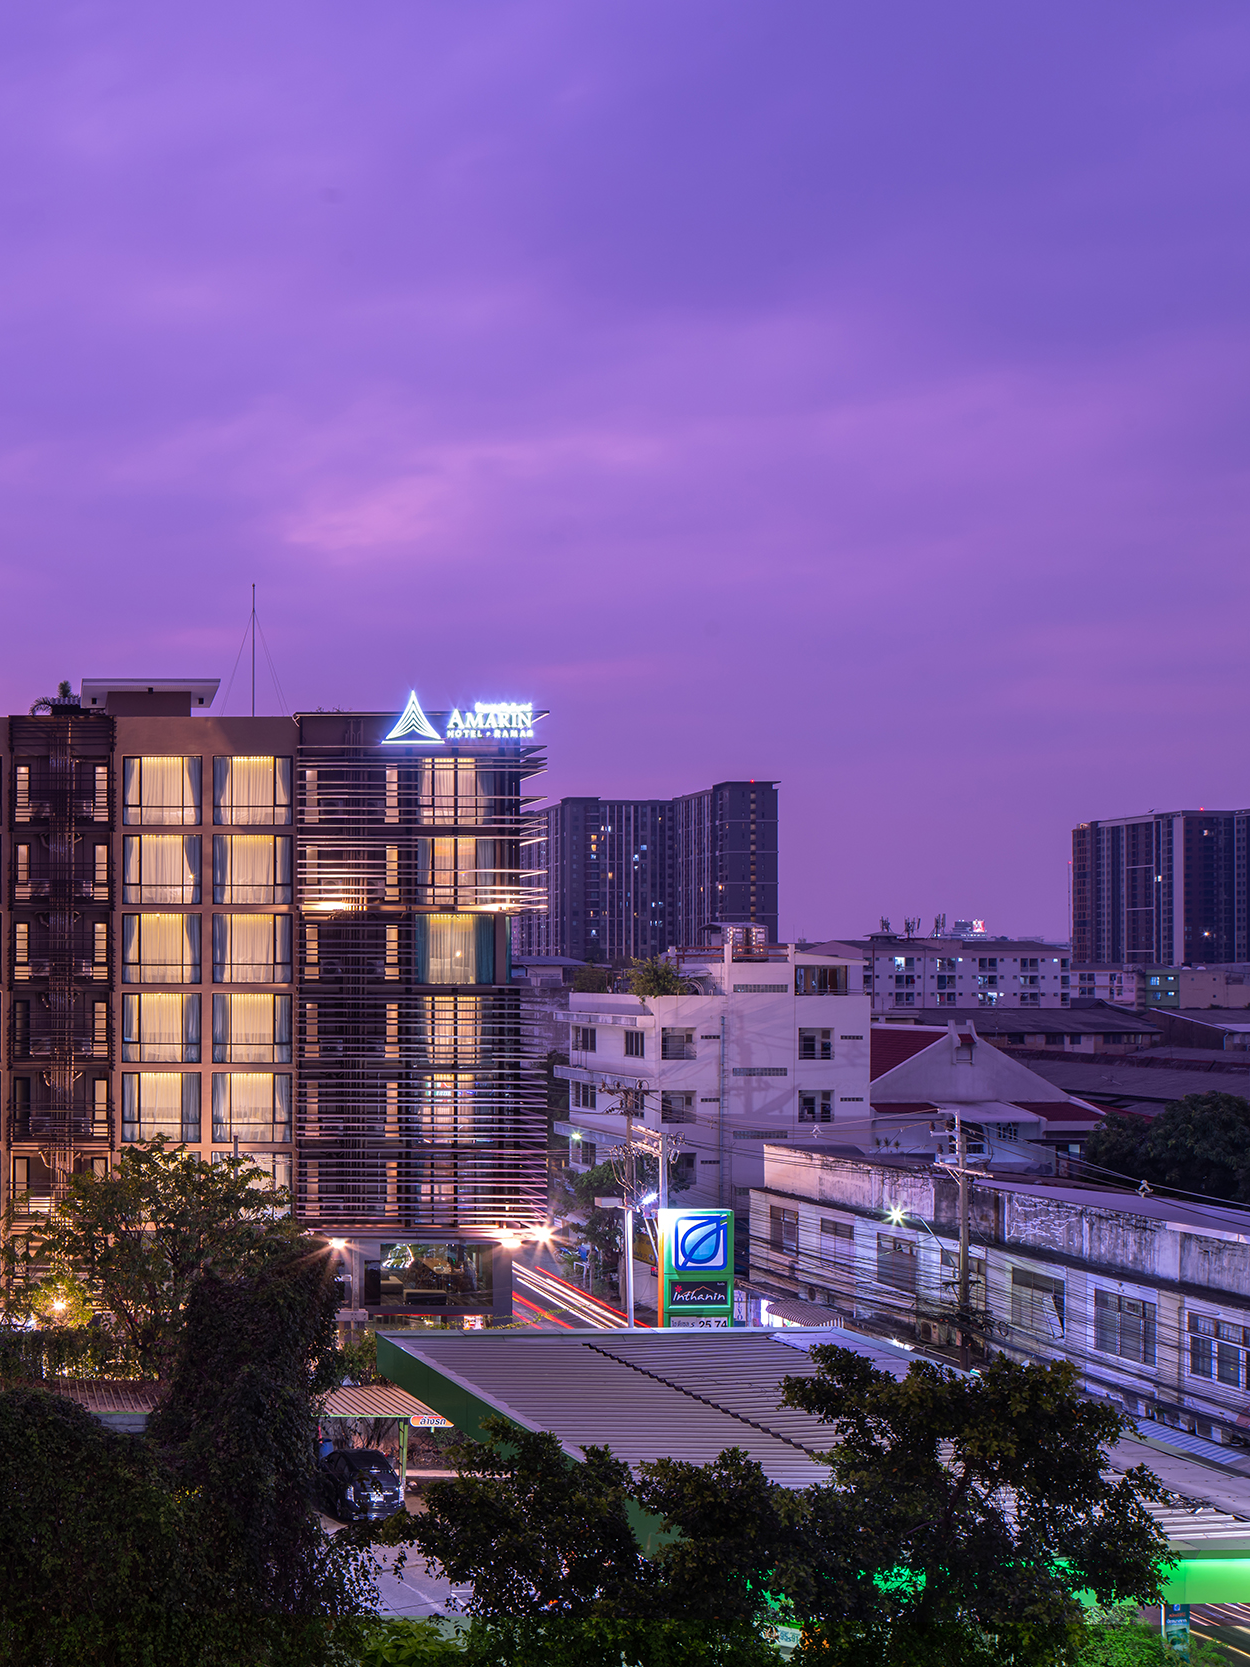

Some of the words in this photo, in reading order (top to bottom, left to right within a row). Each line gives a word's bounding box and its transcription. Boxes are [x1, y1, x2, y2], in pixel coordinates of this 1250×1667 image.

[447, 708, 533, 729] AMARIN
[447, 729, 483, 738] HOTEL
[672, 1290, 726, 1302] Inthanin
[419, 1416, 447, 1426] ล้างรถ
